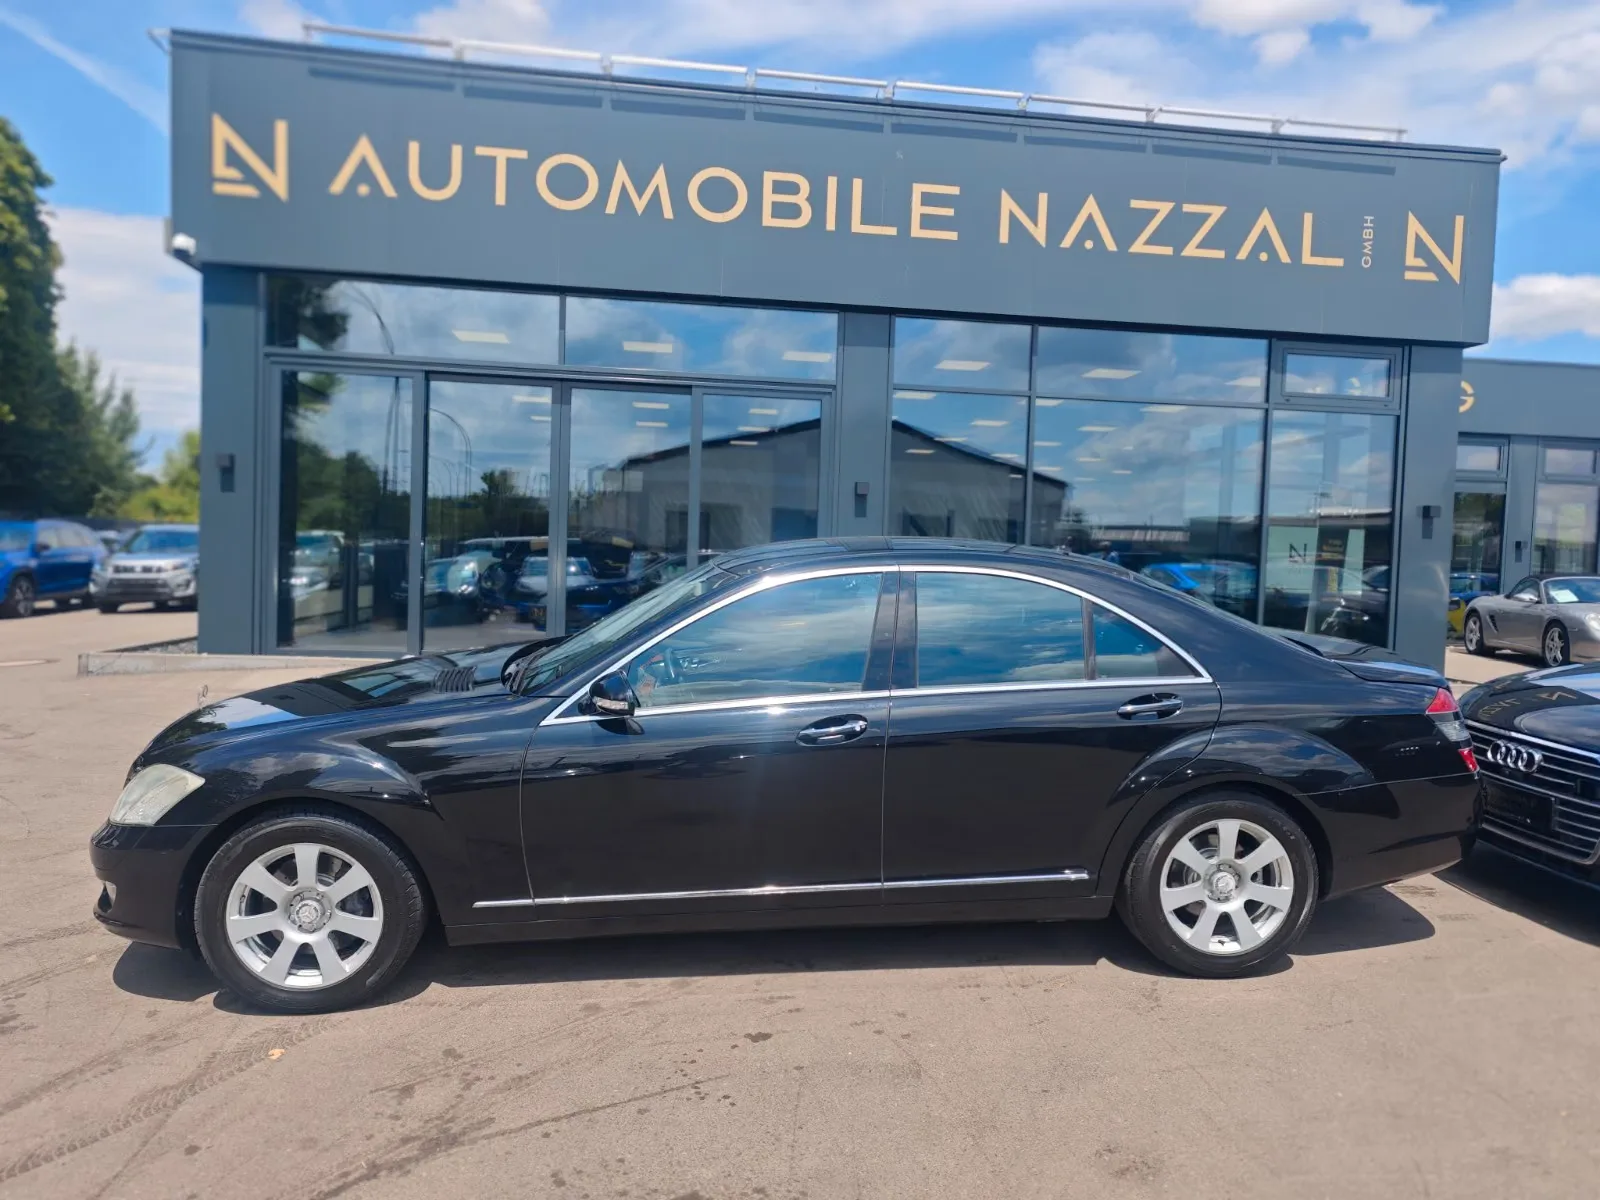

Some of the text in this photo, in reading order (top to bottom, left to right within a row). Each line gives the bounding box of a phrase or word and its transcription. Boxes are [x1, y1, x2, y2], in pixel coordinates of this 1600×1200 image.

[329, 133, 961, 242] AUTOMOBILE
[999, 188, 1344, 268] NAZZAL
[1362, 215, 1375, 268] GMBH
